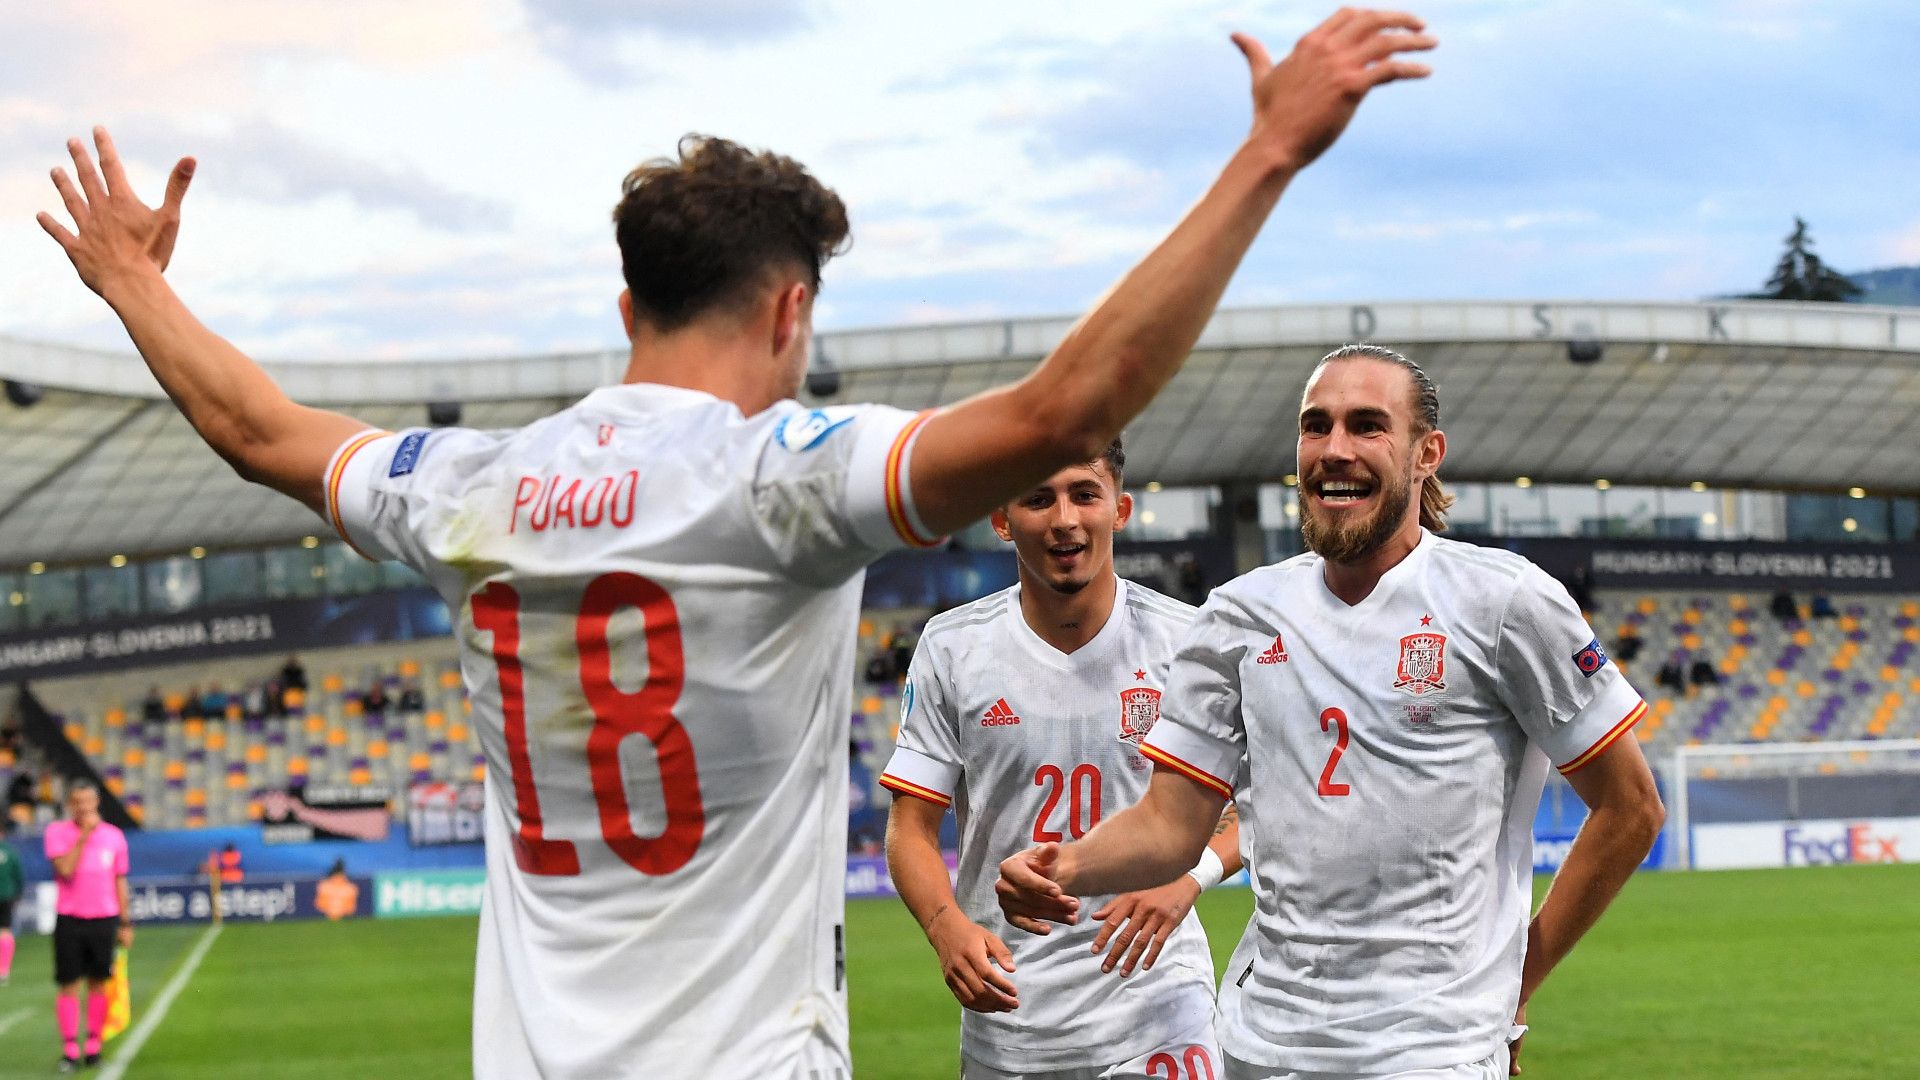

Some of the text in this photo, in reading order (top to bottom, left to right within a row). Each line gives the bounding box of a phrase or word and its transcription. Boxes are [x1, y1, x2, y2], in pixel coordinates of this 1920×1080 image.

[510, 470, 639, 534] PUADO
[1831, 554, 1893, 579] 2021
[211, 614, 272, 644] 2021
[1256, 652, 1288, 664] adidas
[470, 571, 705, 876] 18
[981, 715, 1020, 726] adidas
[1317, 707, 1350, 796] 2
[1033, 764, 1102, 842] 20
[1784, 823, 1901, 864] FedEx
[128, 885, 185, 919] ake
